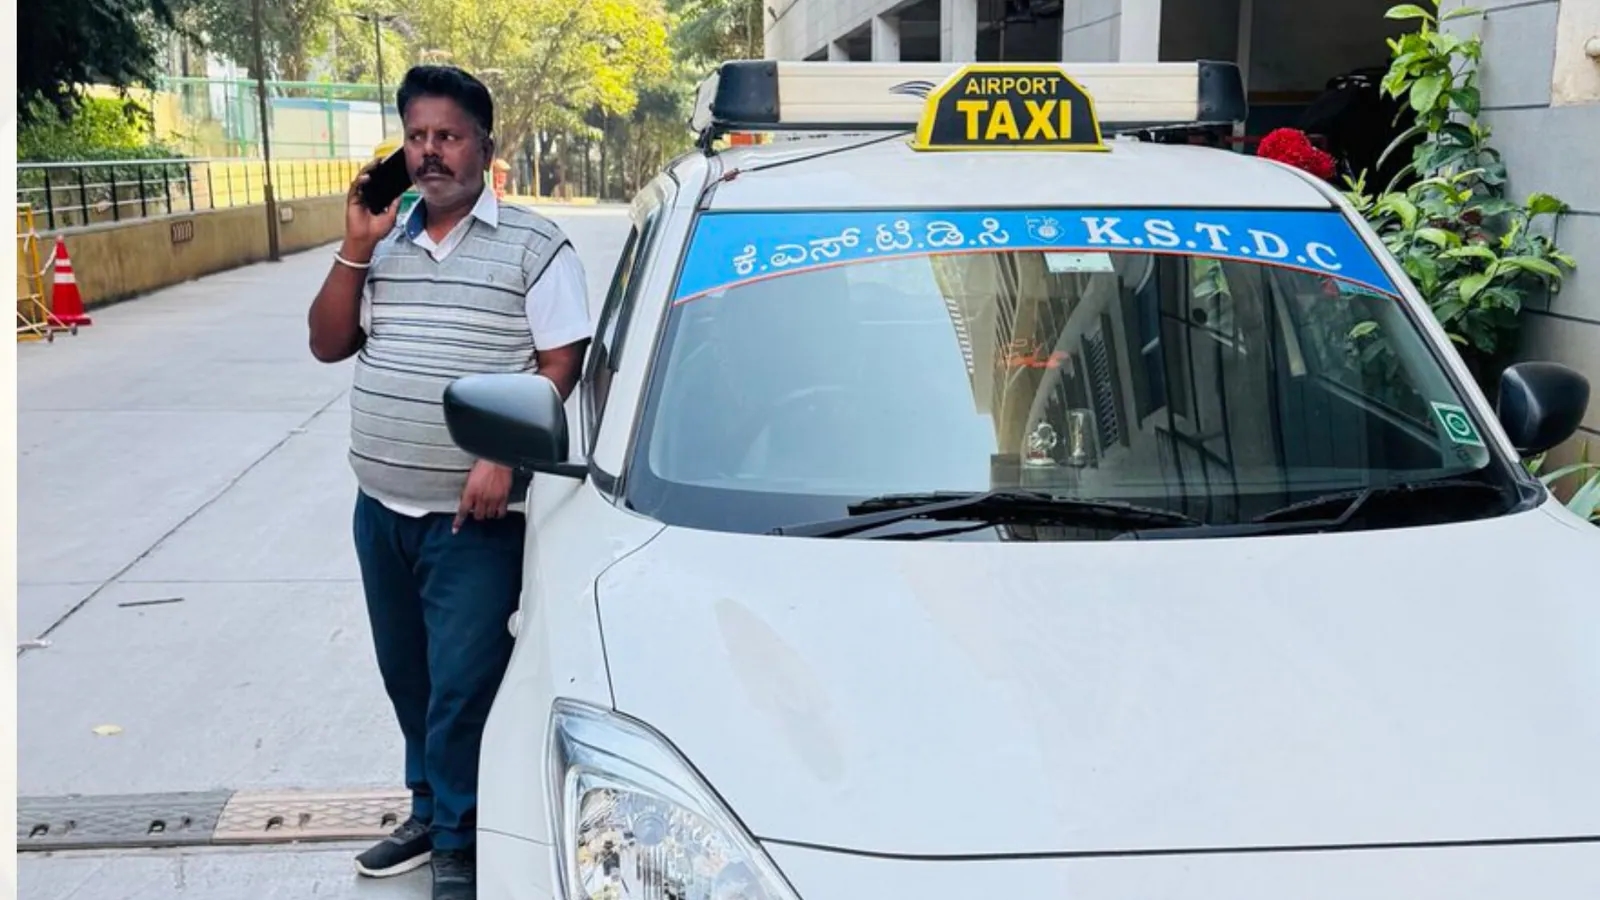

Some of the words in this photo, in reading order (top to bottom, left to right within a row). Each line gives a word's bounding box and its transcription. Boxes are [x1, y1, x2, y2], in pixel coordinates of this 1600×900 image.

[964, 77, 1060, 95] AIRPORT
[956, 99, 1073, 141] TAXI
[1080, 216, 1343, 271] K.S.T.D.C
